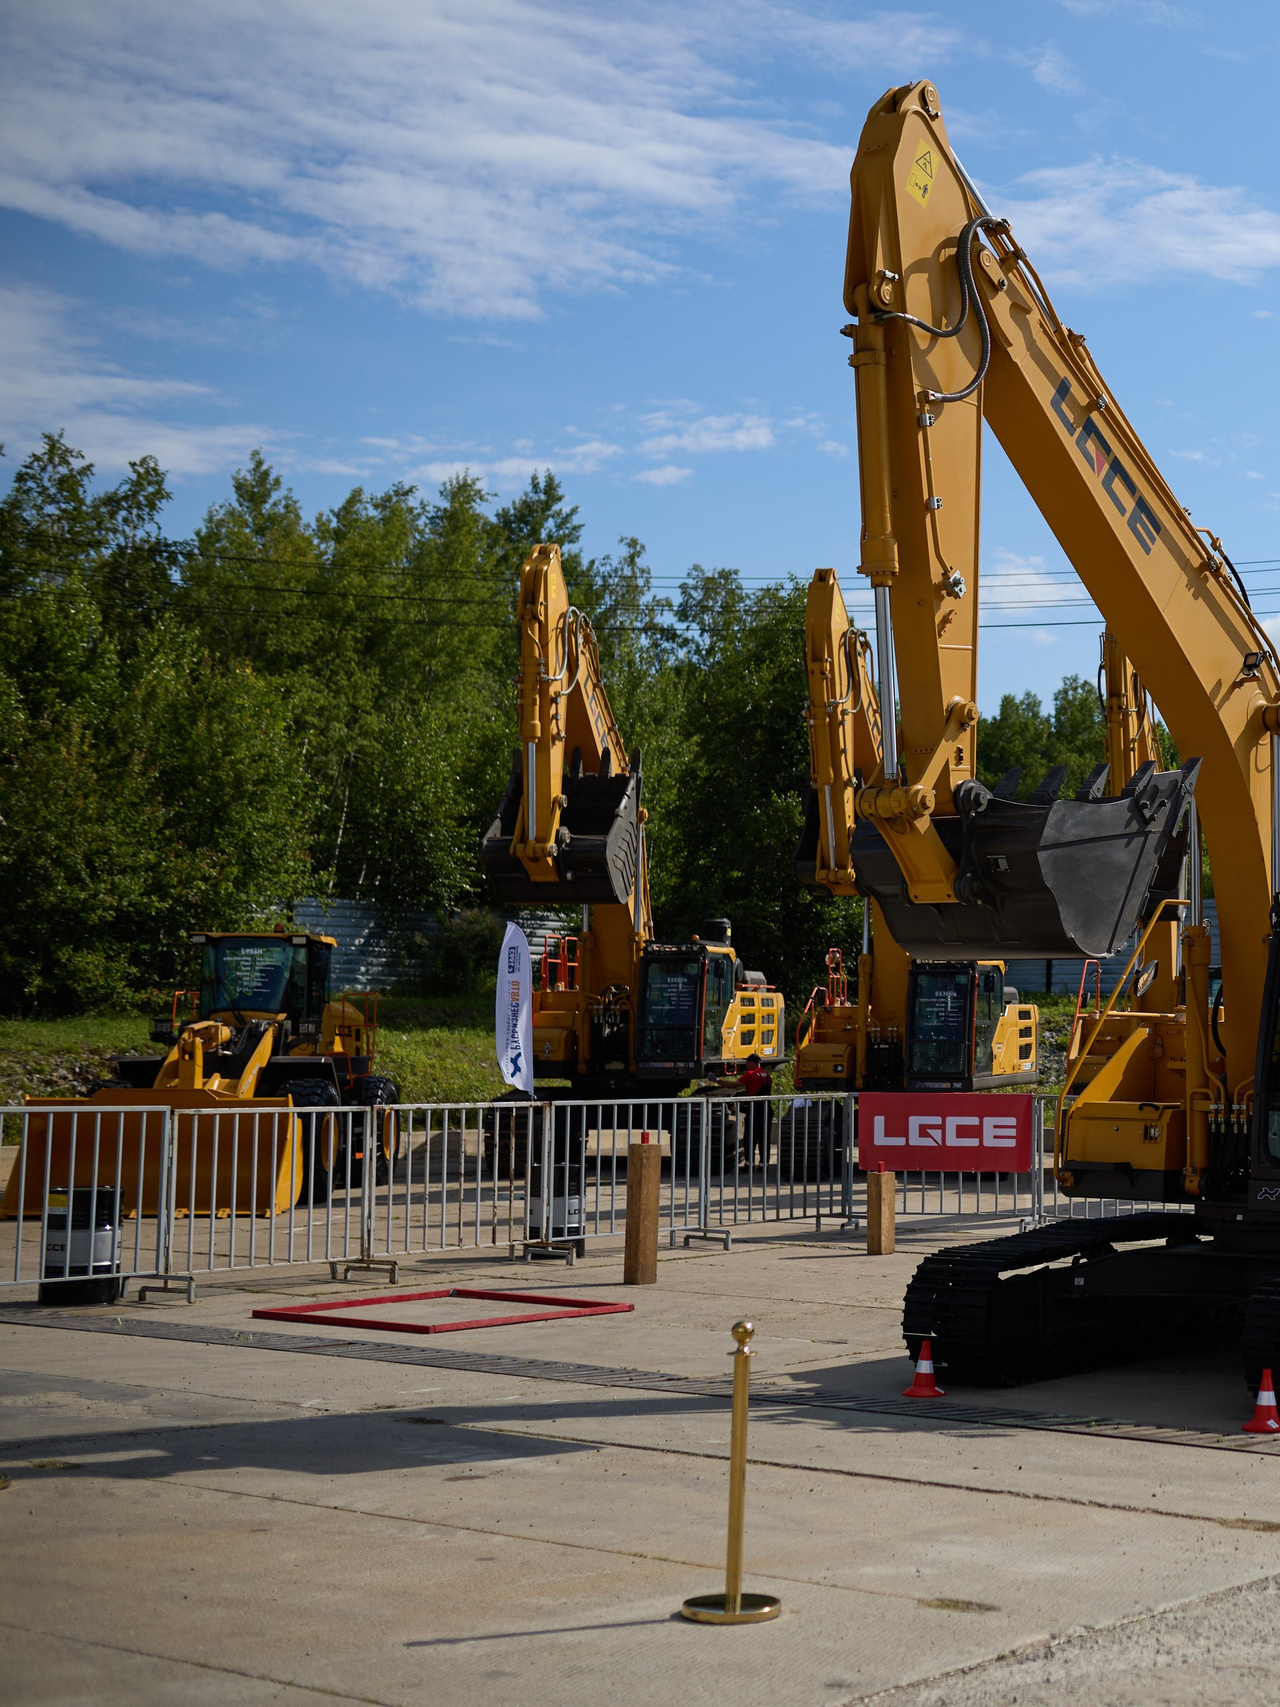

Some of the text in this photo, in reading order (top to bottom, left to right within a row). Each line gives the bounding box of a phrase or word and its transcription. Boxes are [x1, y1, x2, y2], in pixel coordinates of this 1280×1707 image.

[1050, 376, 1162, 556] LGCE
[584, 674, 609, 749] LGCE
[874, 1115, 1017, 1147] LGCE
